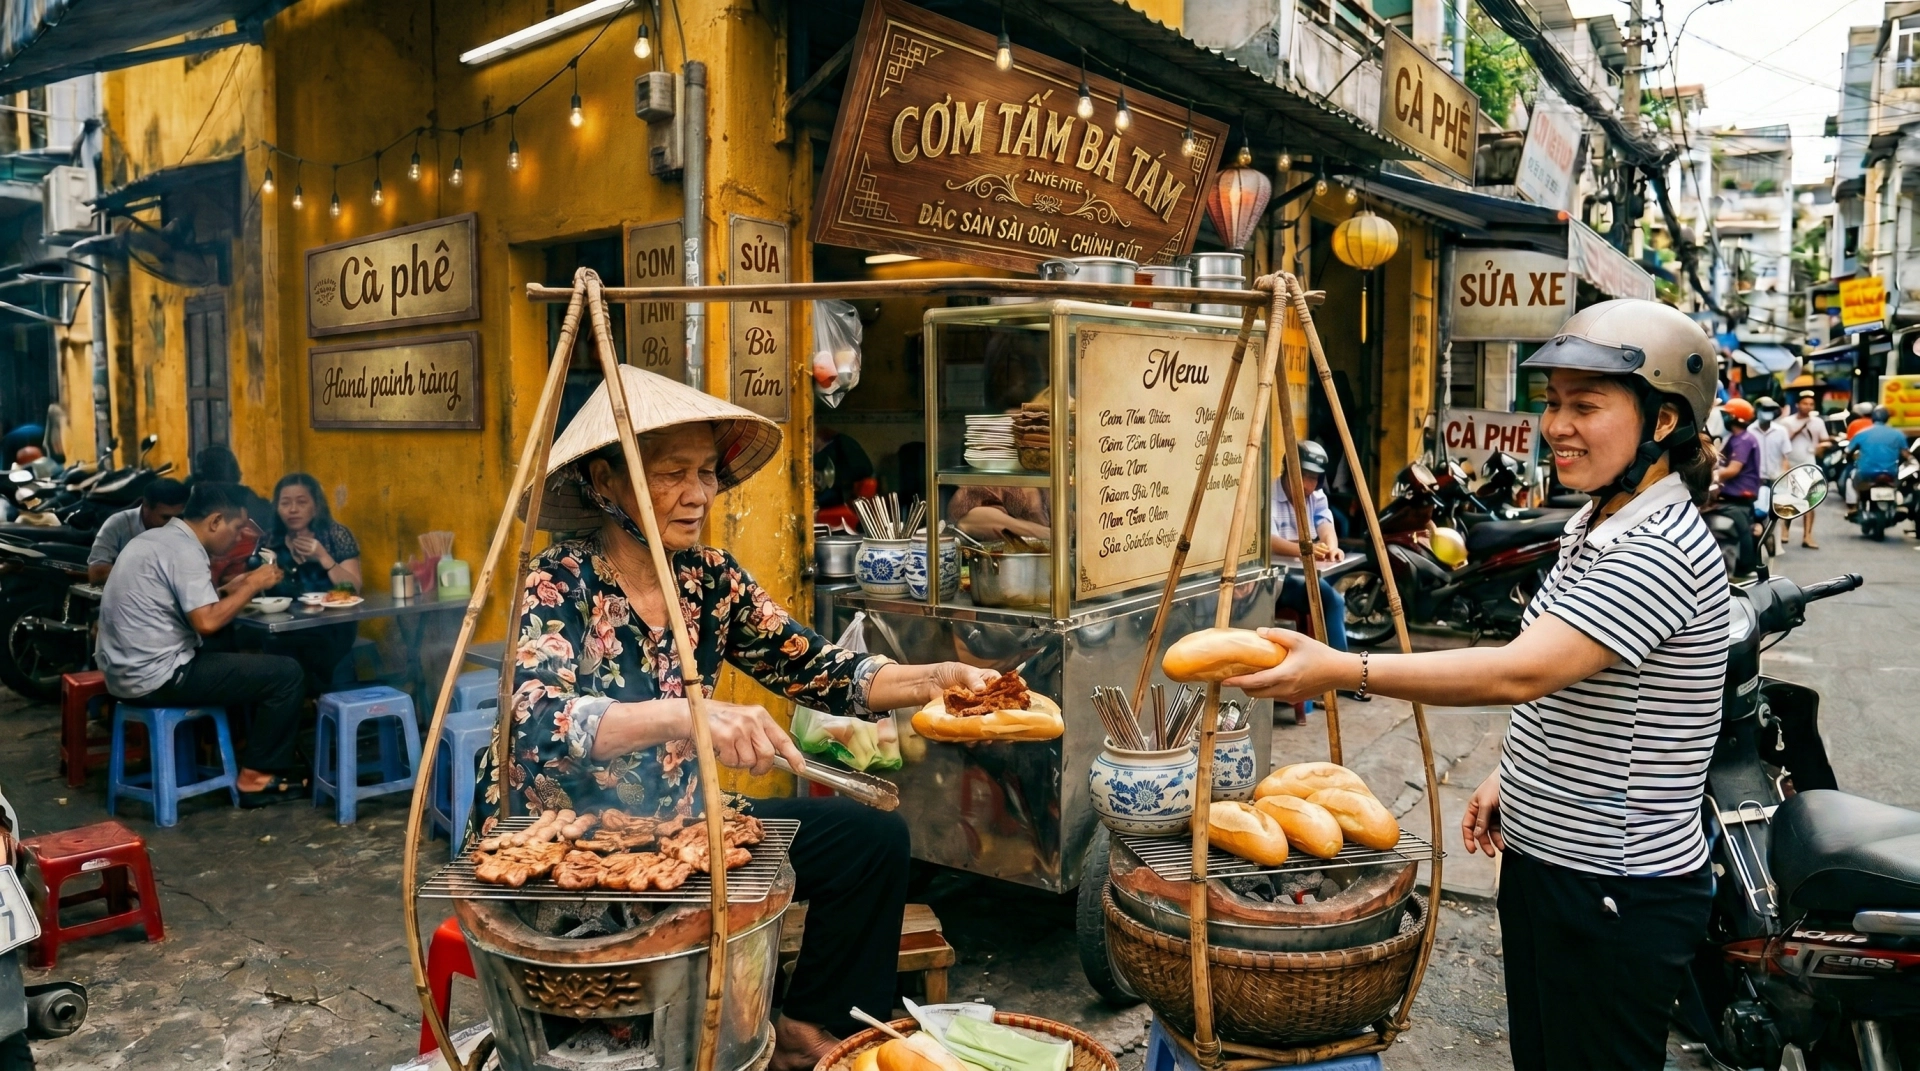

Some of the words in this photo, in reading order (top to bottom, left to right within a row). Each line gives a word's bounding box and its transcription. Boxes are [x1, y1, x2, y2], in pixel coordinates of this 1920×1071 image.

[1394, 64, 1424, 134] CÀ
[1430, 92, 1472, 161] PHÊ
[998, 89, 1077, 165] TẤM
[1075, 120, 1122, 183] BÀ
[1124, 146, 1187, 224] TÁM
[636, 245, 676, 279] COM
[740, 234, 780, 274] SỬA
[340, 256, 384, 311] Cà
[391, 239, 455, 317] phê
[1460, 260, 1519, 307] SỬA
[1527, 272, 1567, 306] XE
[642, 336, 672, 368] Bà
[745, 326, 778, 356] Bà
[323, 366, 368, 405] Hand
[739, 366, 783, 398] Tám
[1143, 348, 1210, 392] Menu
[1446, 415, 1477, 449] CÀ
[1484, 420, 1532, 454] PHÊ
